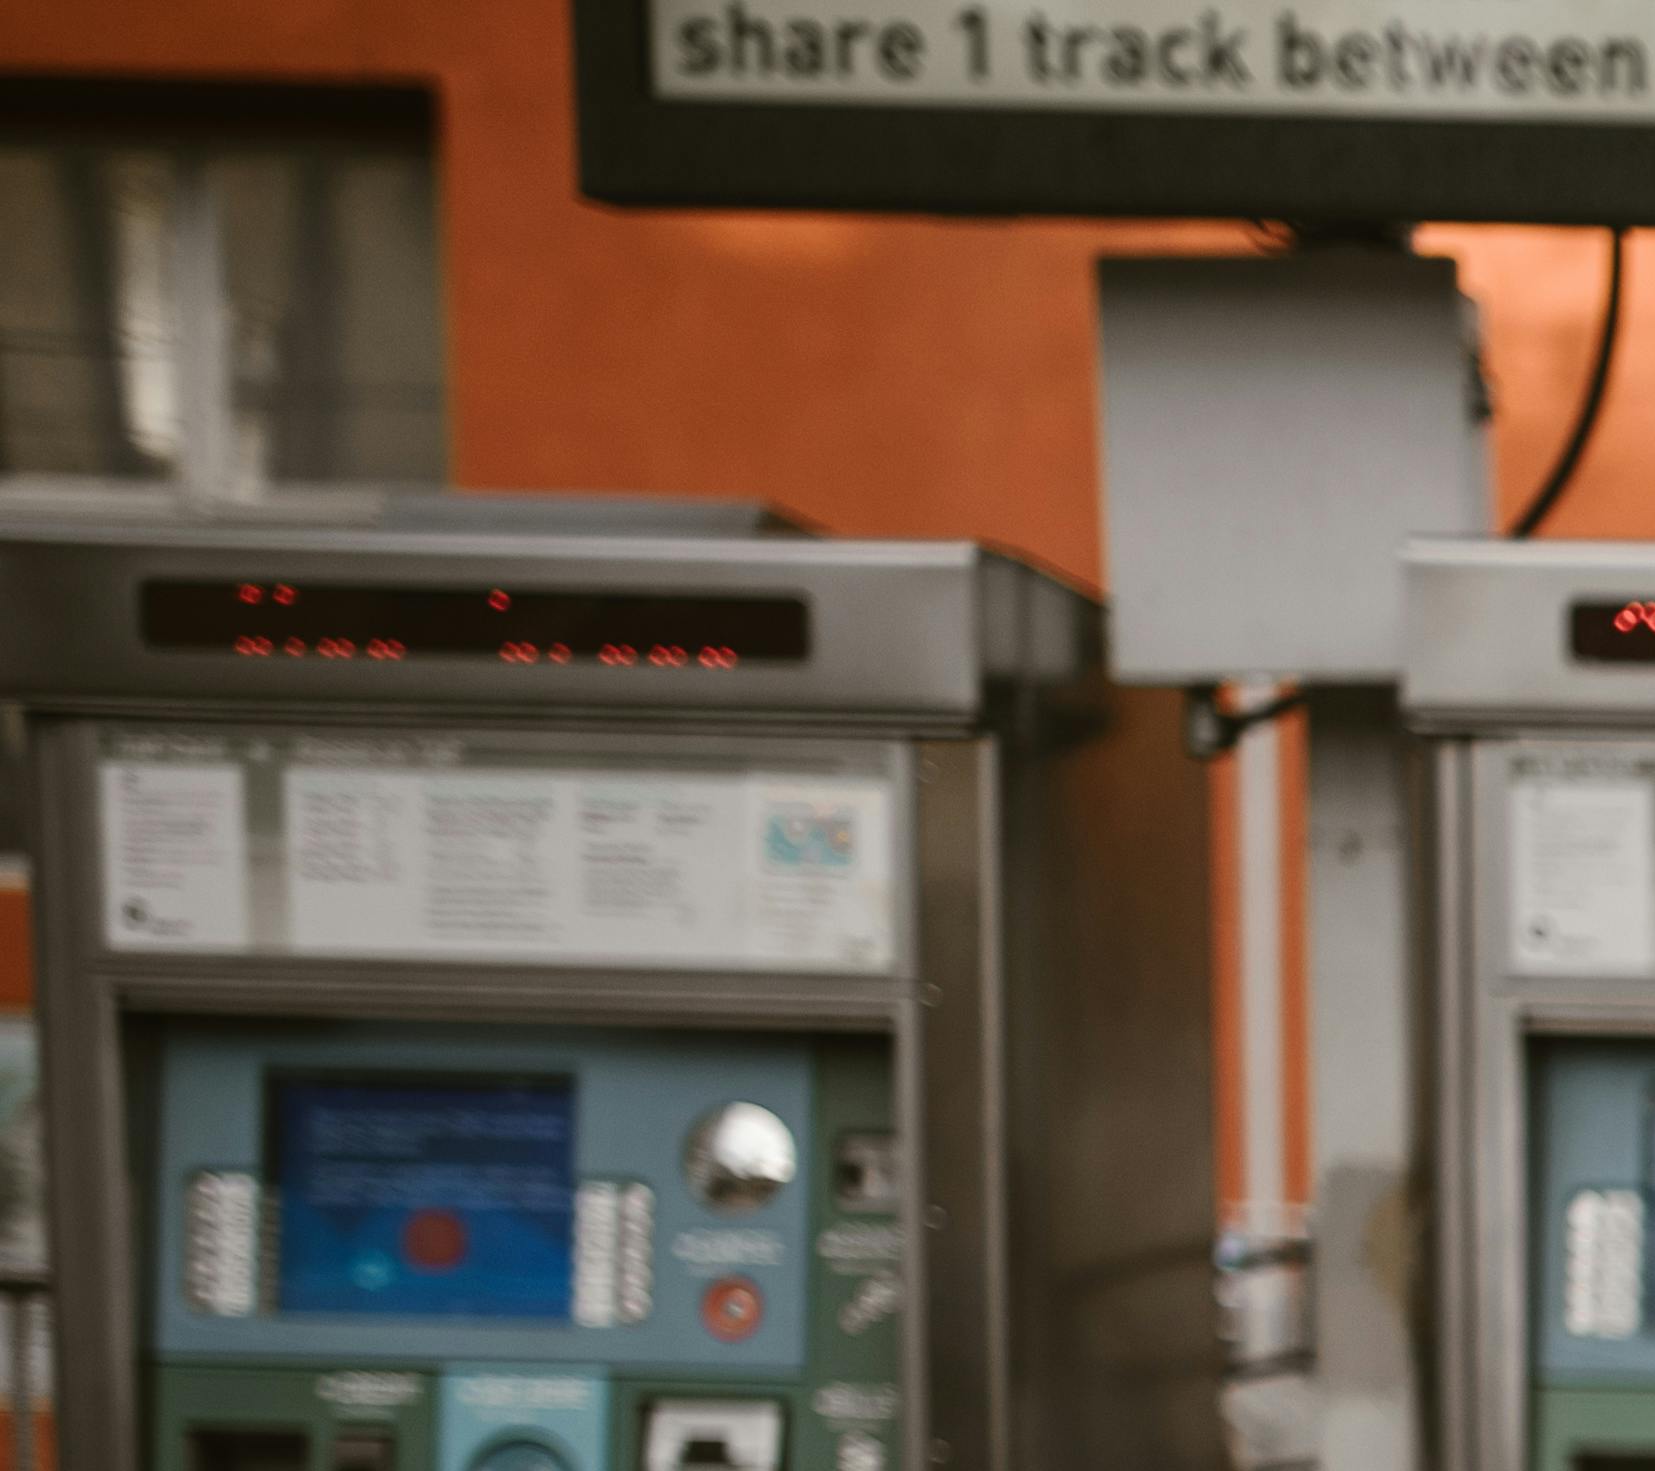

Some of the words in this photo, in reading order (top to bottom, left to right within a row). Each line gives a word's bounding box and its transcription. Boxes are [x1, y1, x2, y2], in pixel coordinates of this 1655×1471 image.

[677, 0, 926, 82] share
[956, 4, 992, 84] 1
[1023, 3, 1252, 88] track
[1274, 8, 1649, 95] between
